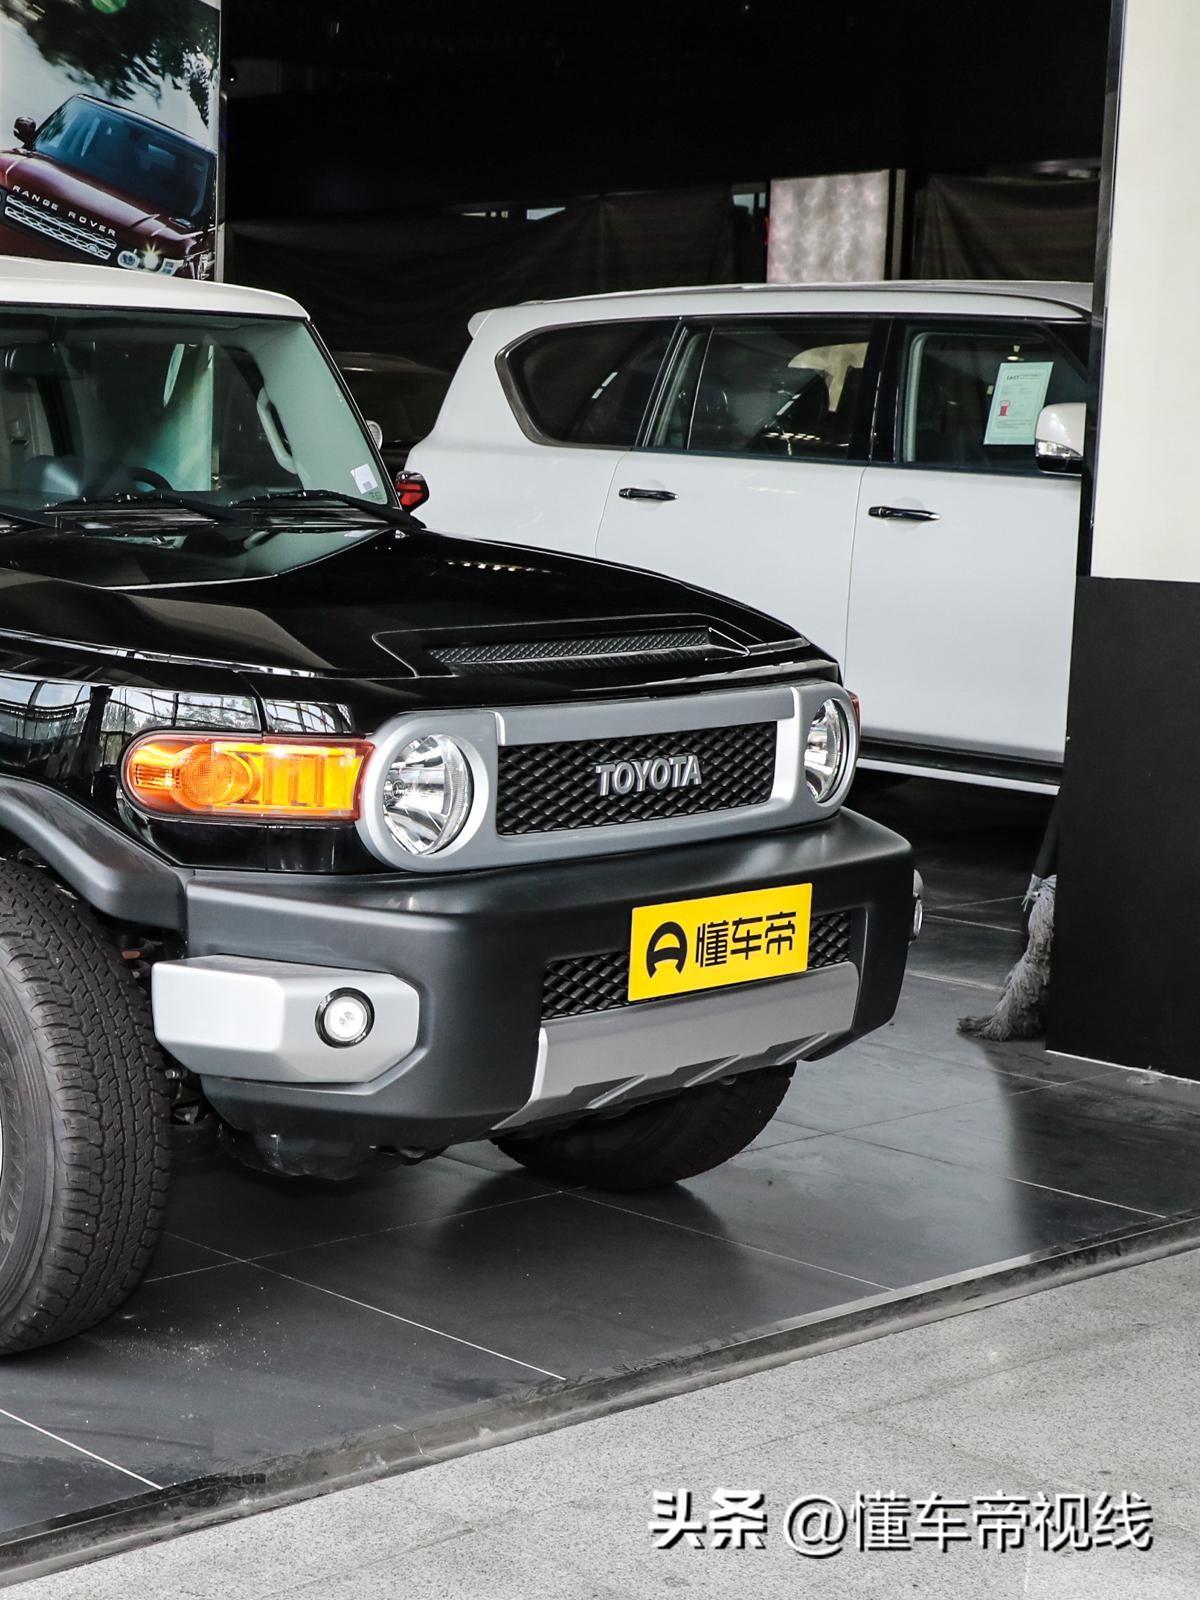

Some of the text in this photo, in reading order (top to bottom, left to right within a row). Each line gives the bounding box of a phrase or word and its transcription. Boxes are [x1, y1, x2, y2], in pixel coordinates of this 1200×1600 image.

[12, 184, 117, 237] RANGE ROVER
[595, 754, 702, 796] TOYOTA
[695, 911, 797, 968] 懂车帝
